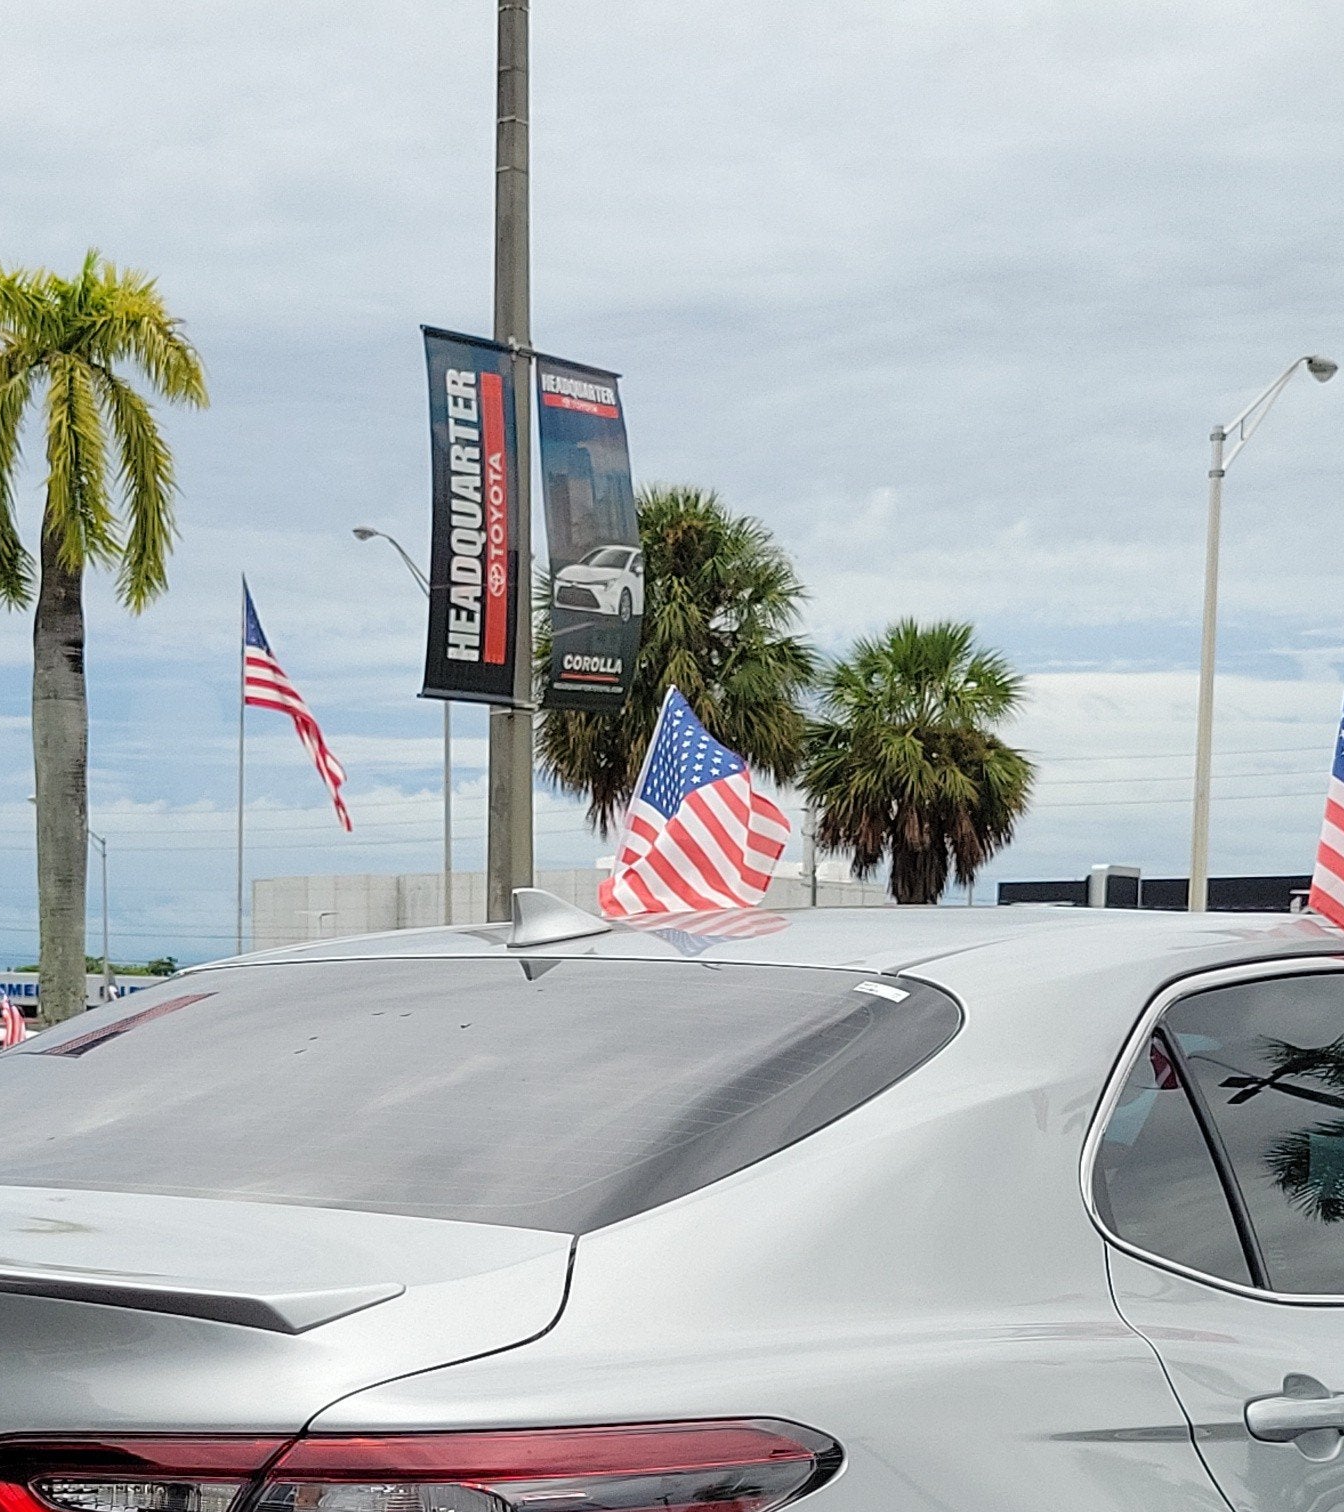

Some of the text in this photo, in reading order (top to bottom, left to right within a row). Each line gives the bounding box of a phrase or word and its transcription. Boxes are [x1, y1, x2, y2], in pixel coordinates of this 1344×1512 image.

[541, 374, 617, 406] HEADQUARTER
[446, 368, 486, 663] HEADQUARTER
[490, 452, 504, 560] TOYOTA
[563, 653, 623, 675] COROLLA
